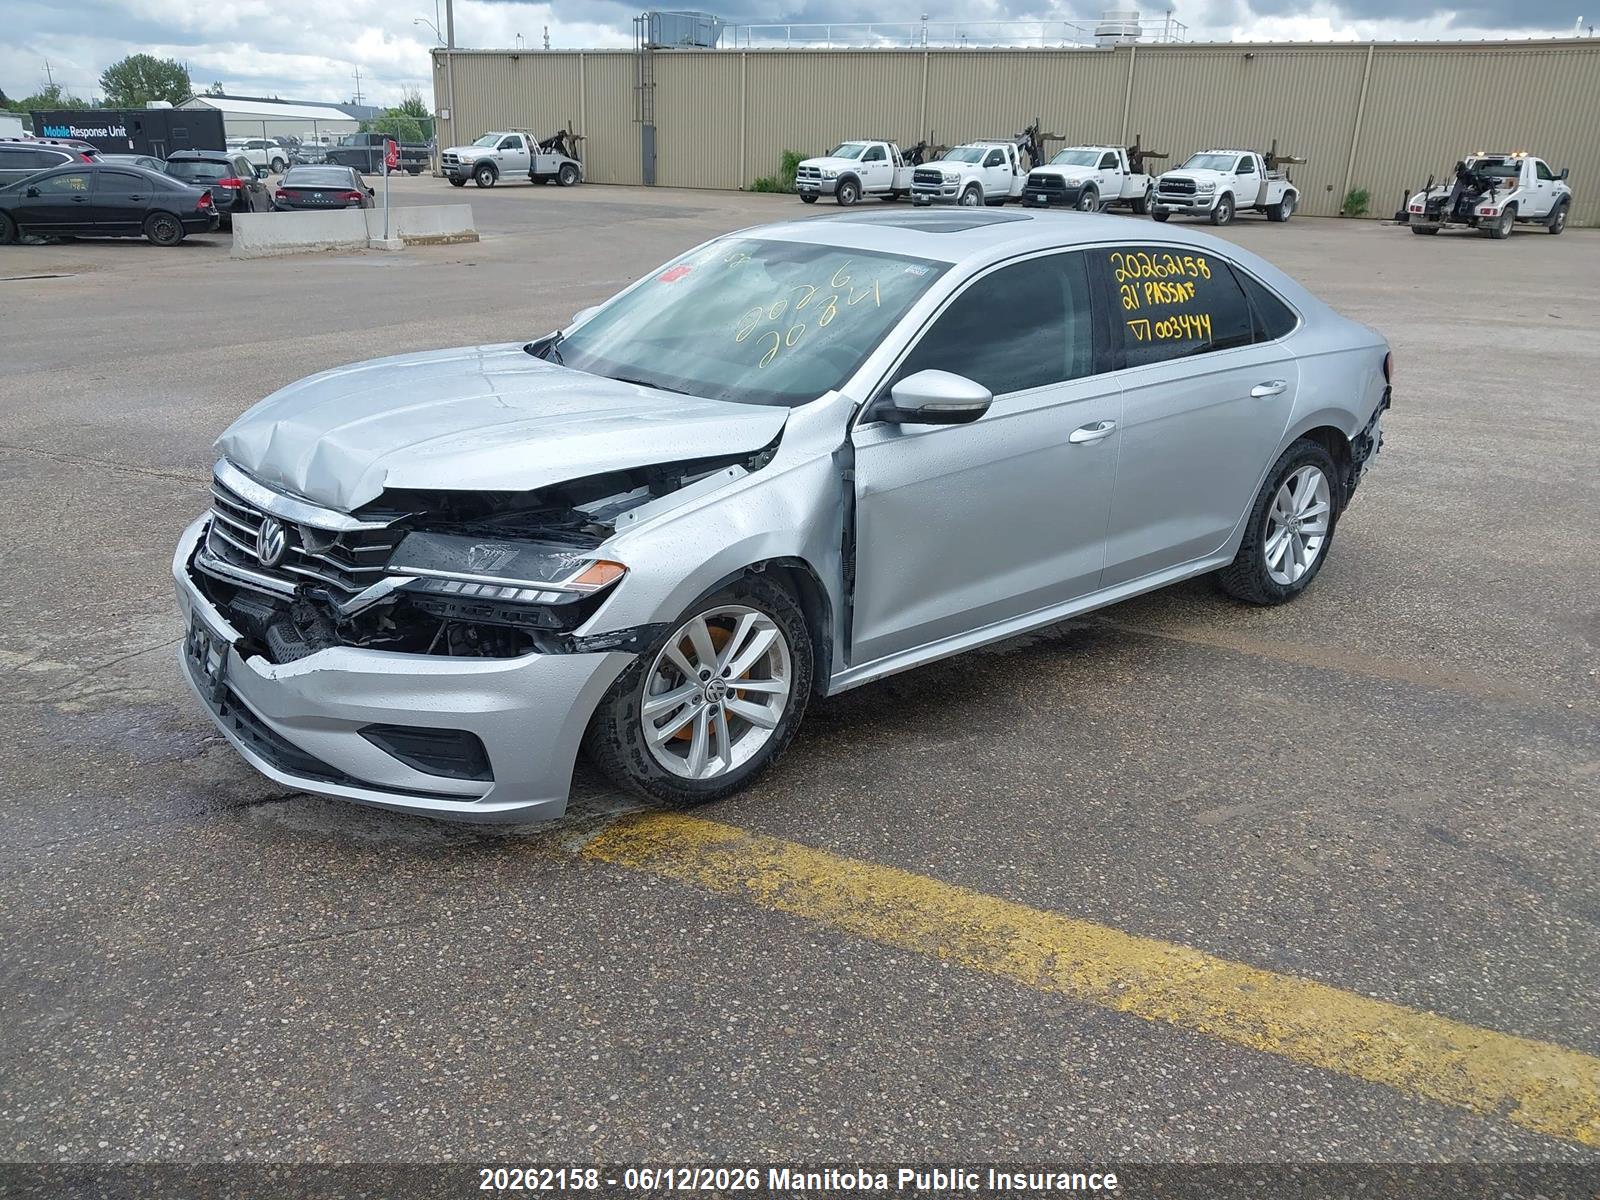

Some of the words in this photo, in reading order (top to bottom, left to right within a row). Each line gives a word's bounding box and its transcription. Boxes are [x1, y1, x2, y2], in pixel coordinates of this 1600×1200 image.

[43, 125, 70, 137] Mobile
[69, 125, 107, 138] Response
[108, 125, 126, 137] Unit
[1110, 252, 1211, 283] 20262158
